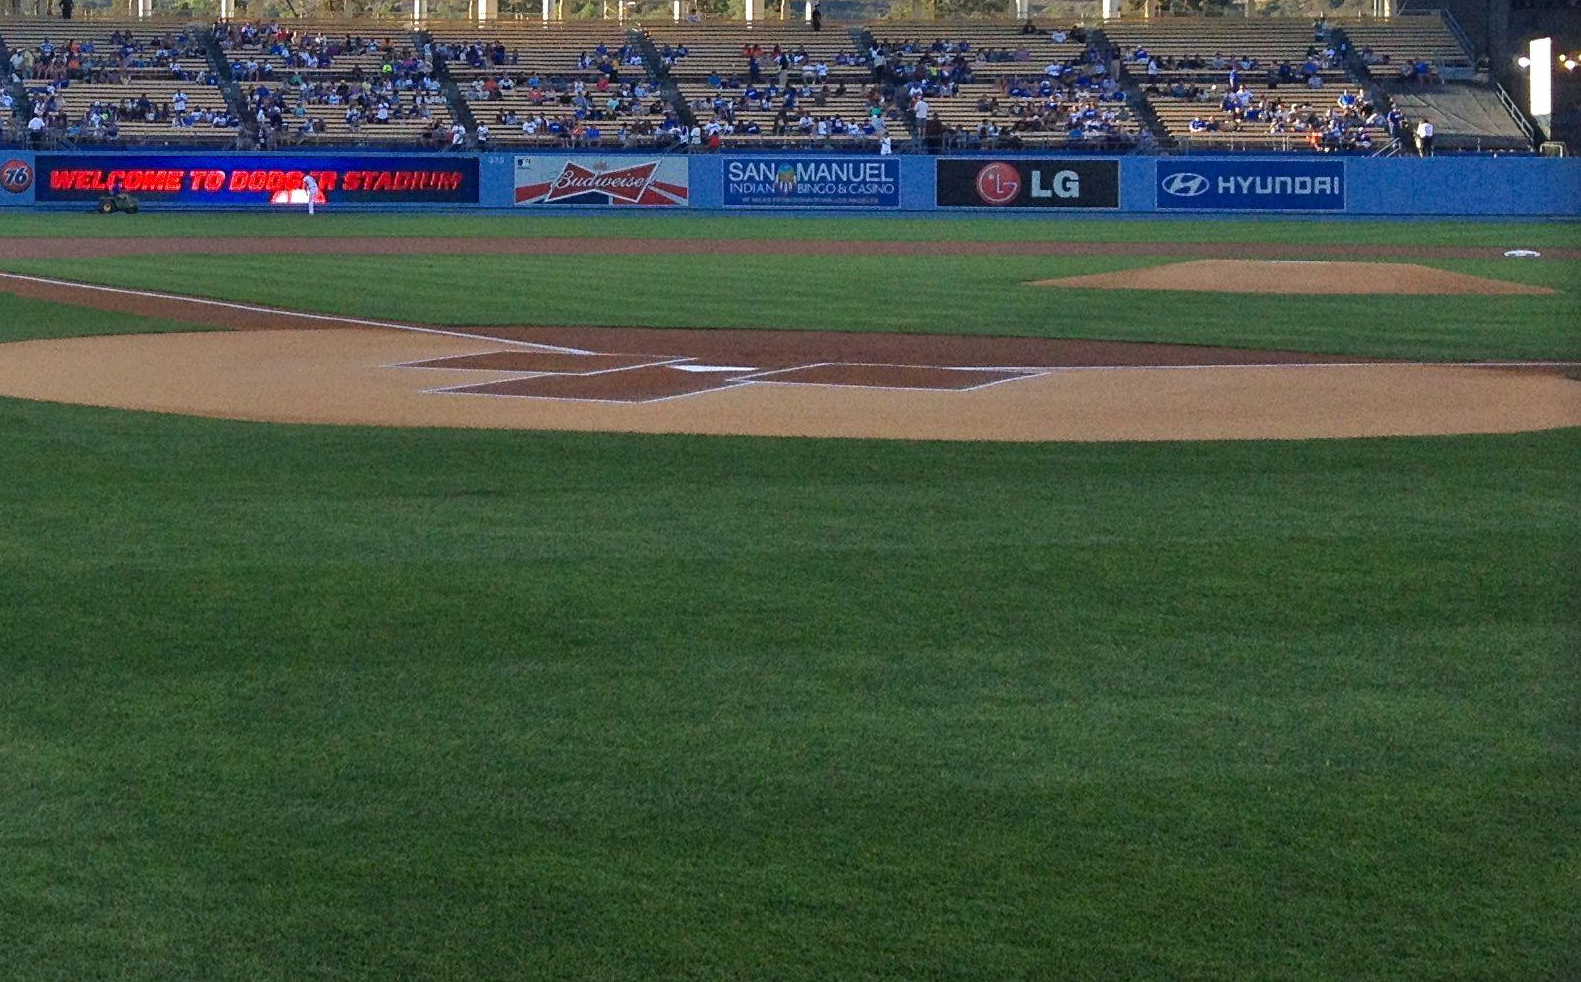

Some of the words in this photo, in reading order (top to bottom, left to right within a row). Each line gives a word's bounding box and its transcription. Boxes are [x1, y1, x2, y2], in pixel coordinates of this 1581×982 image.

[4, 165, 29, 185] 76
[49, 170, 184, 191] WELCOME
[188, 171, 226, 191] TO
[342, 171, 463, 191] STADIUM
[552, 170, 656, 190] Budweiser
[729, 162, 775, 182] SAN
[796, 162, 895, 182] MANUEL
[730, 183, 775, 194] INDIAN
[797, 183, 837, 194] BINGO
[848, 183, 895, 194] CASINO
[1031, 170, 1080, 198] LG
[1218, 176, 1340, 195] HYUNDAI
